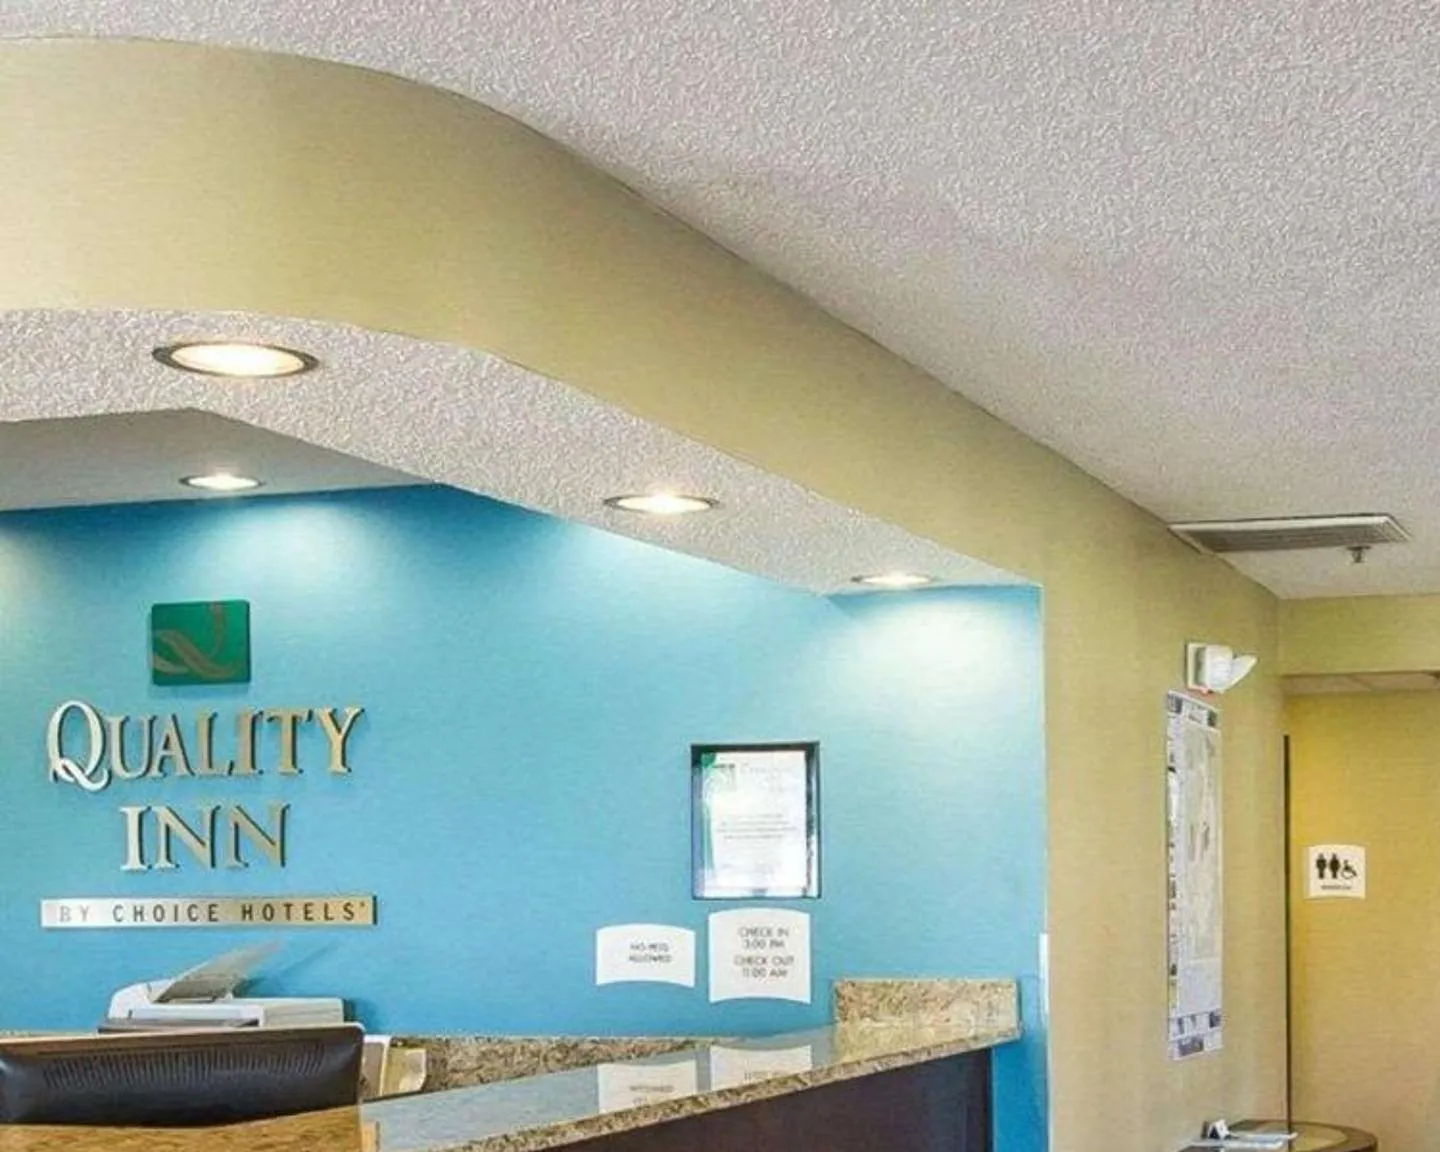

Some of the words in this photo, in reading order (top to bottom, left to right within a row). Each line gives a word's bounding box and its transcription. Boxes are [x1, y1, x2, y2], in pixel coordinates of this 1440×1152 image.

[47, 699, 364, 792] QUALITY
[119, 803, 291, 872] INN
[59, 905, 92, 922] BY
[112, 904, 219, 922] CHOICE
[738, 926, 773, 937] CHECK
[733, 954, 768, 965] CHECK
[772, 954, 795, 966] OUT
